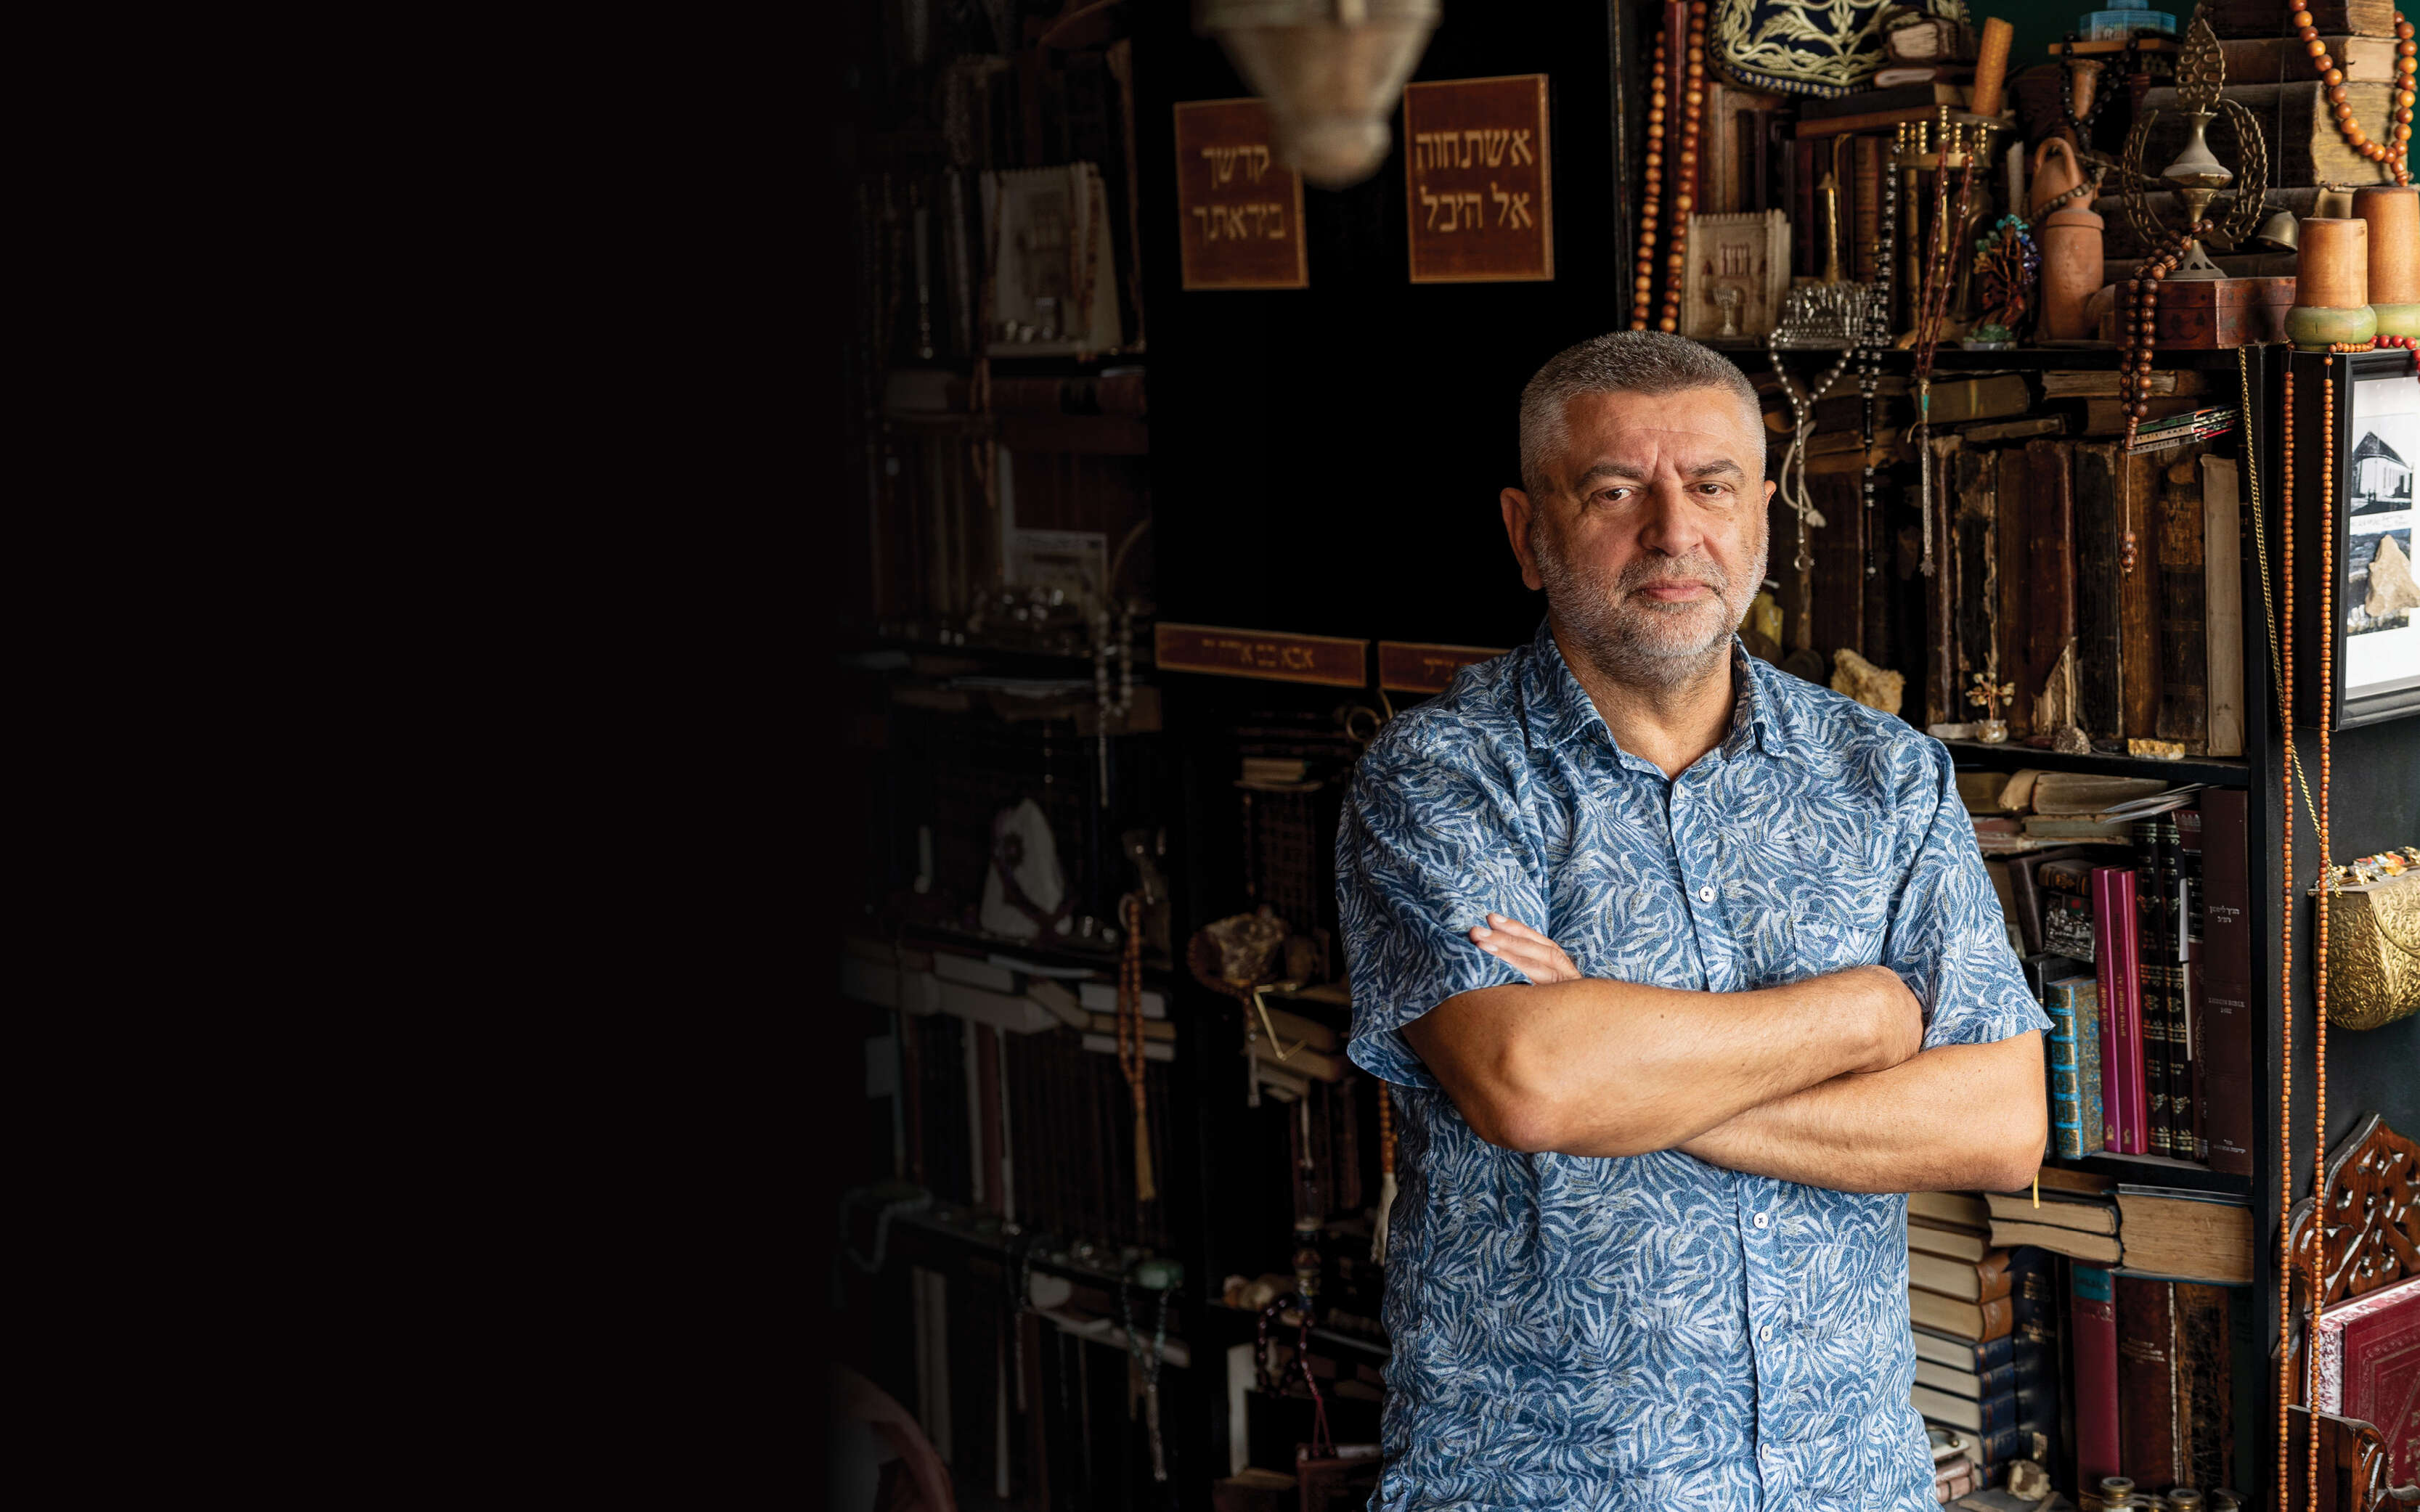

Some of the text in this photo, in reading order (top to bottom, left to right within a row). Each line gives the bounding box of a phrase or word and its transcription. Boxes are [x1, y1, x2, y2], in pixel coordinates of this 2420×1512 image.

[1201, 144, 1270, 190] קדשך
[1416, 128, 1533, 170] אשתחוה
[1192, 203, 1286, 247] ביראתך
[1420, 181, 1532, 232] אל היכל
